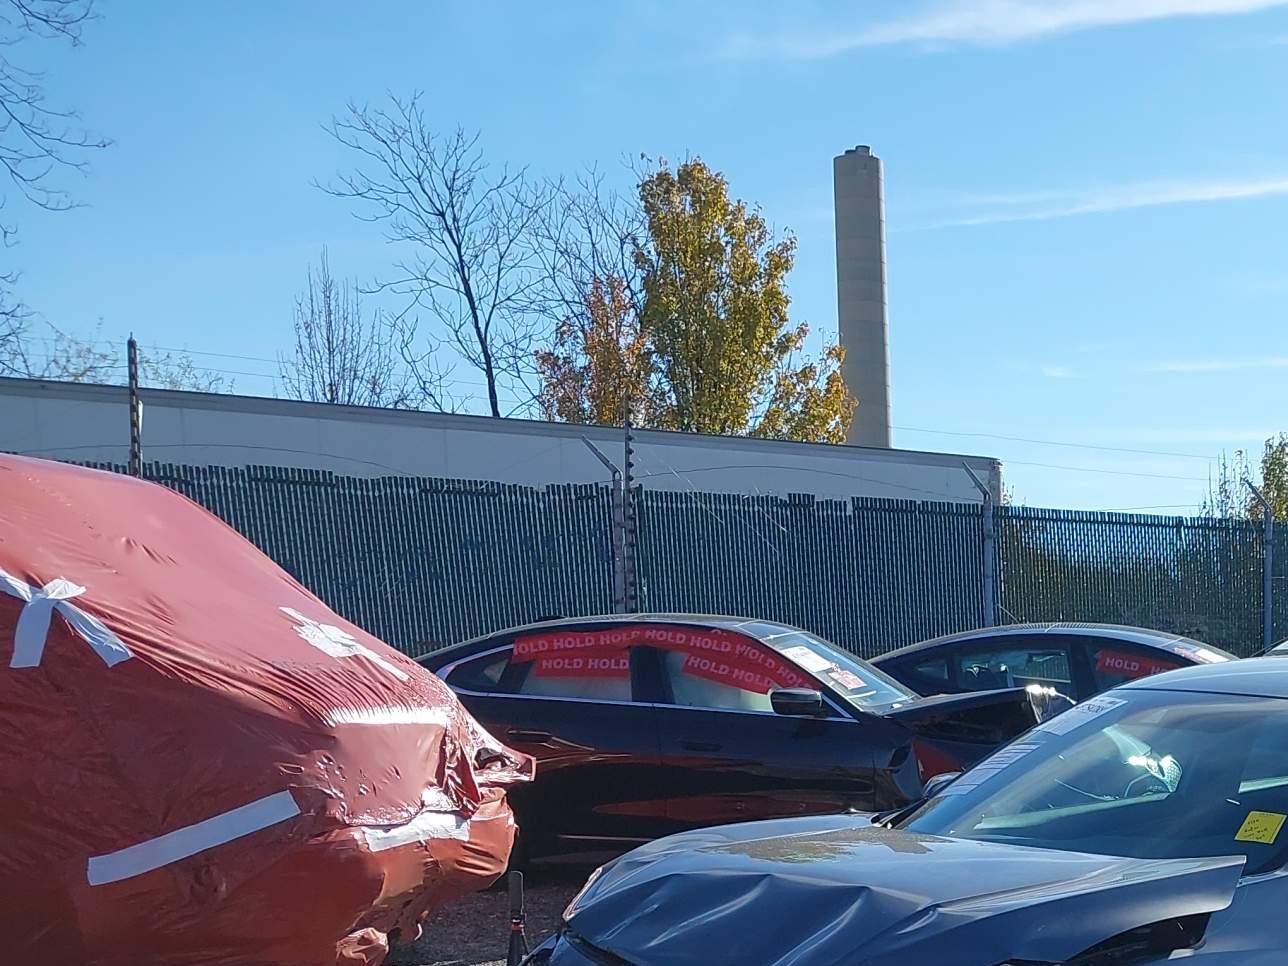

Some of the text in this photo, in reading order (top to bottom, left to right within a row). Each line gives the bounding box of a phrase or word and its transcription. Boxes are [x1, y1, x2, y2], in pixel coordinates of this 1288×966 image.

[553, 637, 595, 650] HOLD
[645, 629, 685, 645] HOLD
[690, 636, 731, 653] HOLD
[542, 659, 629, 669] HOLD HOLD
[687, 655, 772, 687] HOLD HOLD
[1105, 657, 1140, 671] HOLD
